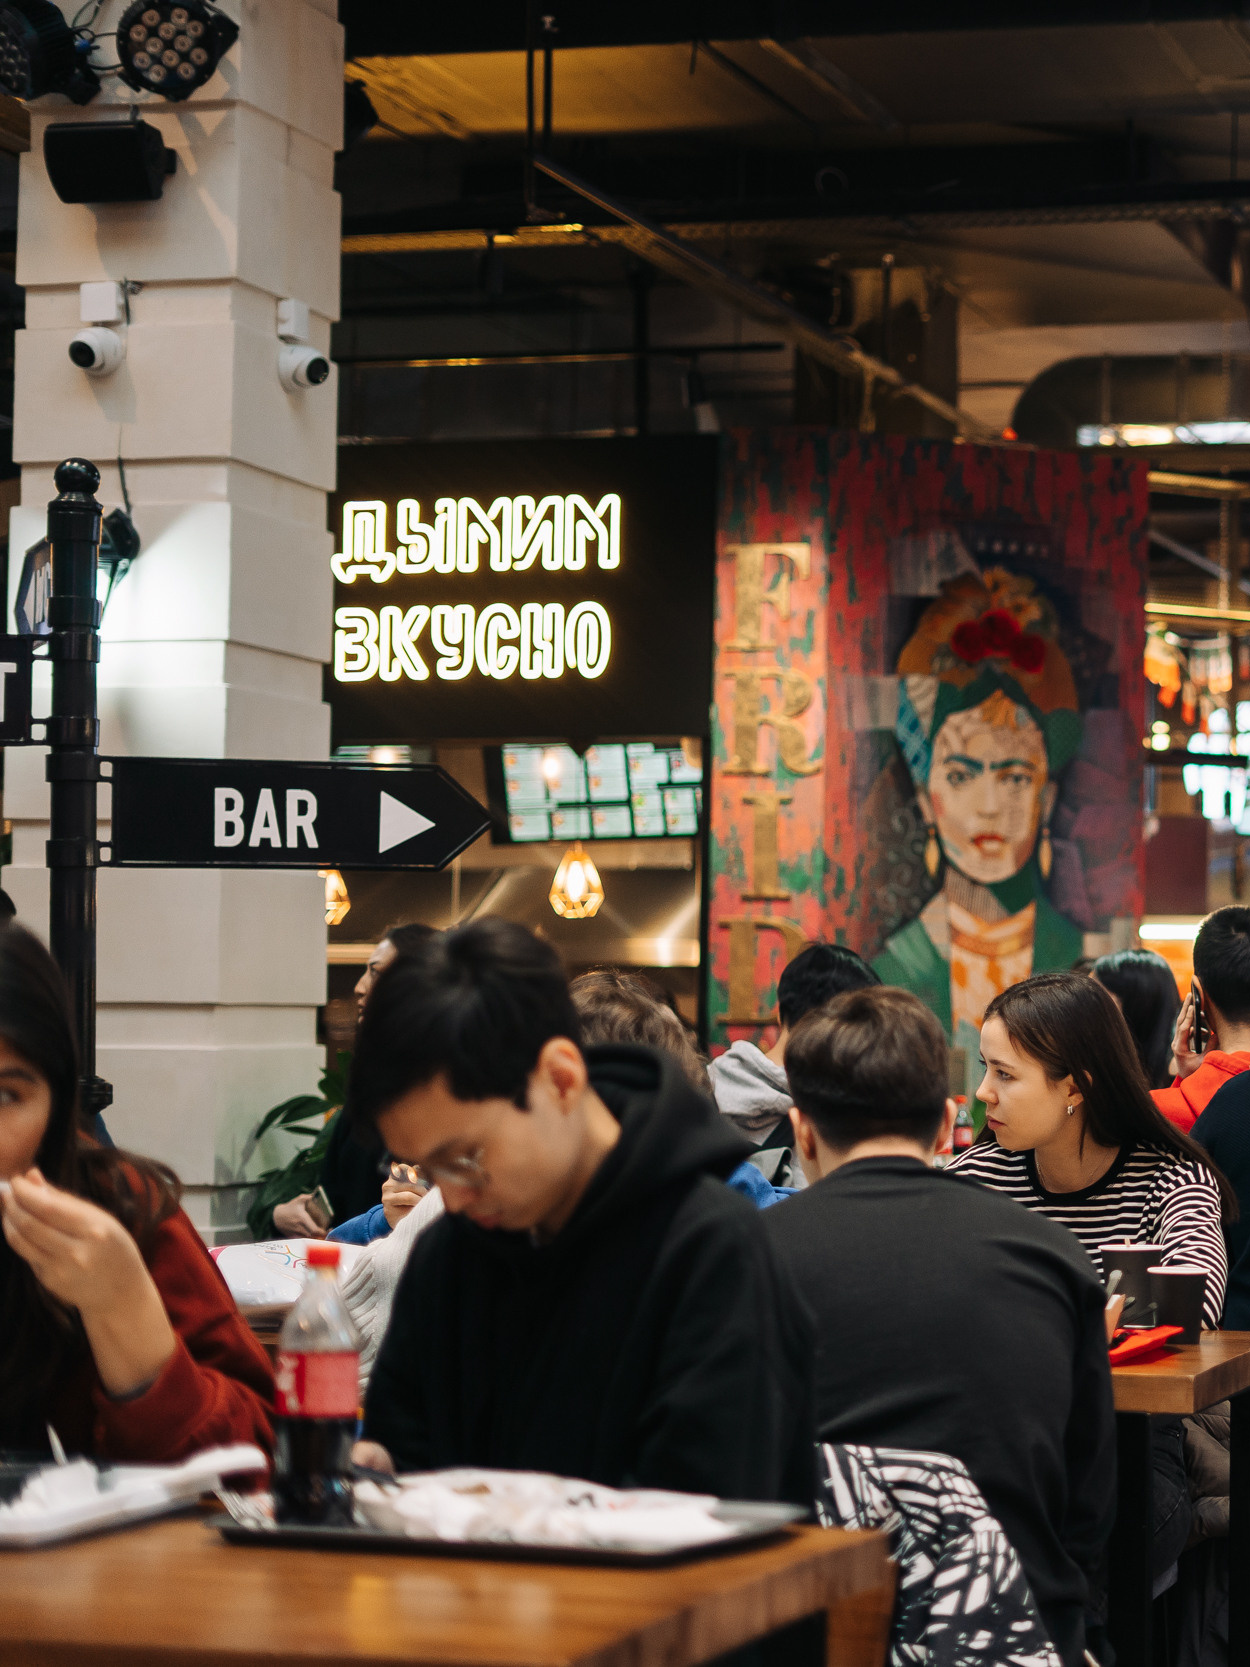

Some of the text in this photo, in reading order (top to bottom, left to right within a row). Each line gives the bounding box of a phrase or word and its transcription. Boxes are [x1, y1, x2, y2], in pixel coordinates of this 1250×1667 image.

[331, 494, 621, 584] ДЫМИМ
[334, 601, 612, 682] ВКУСНО
[213, 787, 319, 849] BAR
